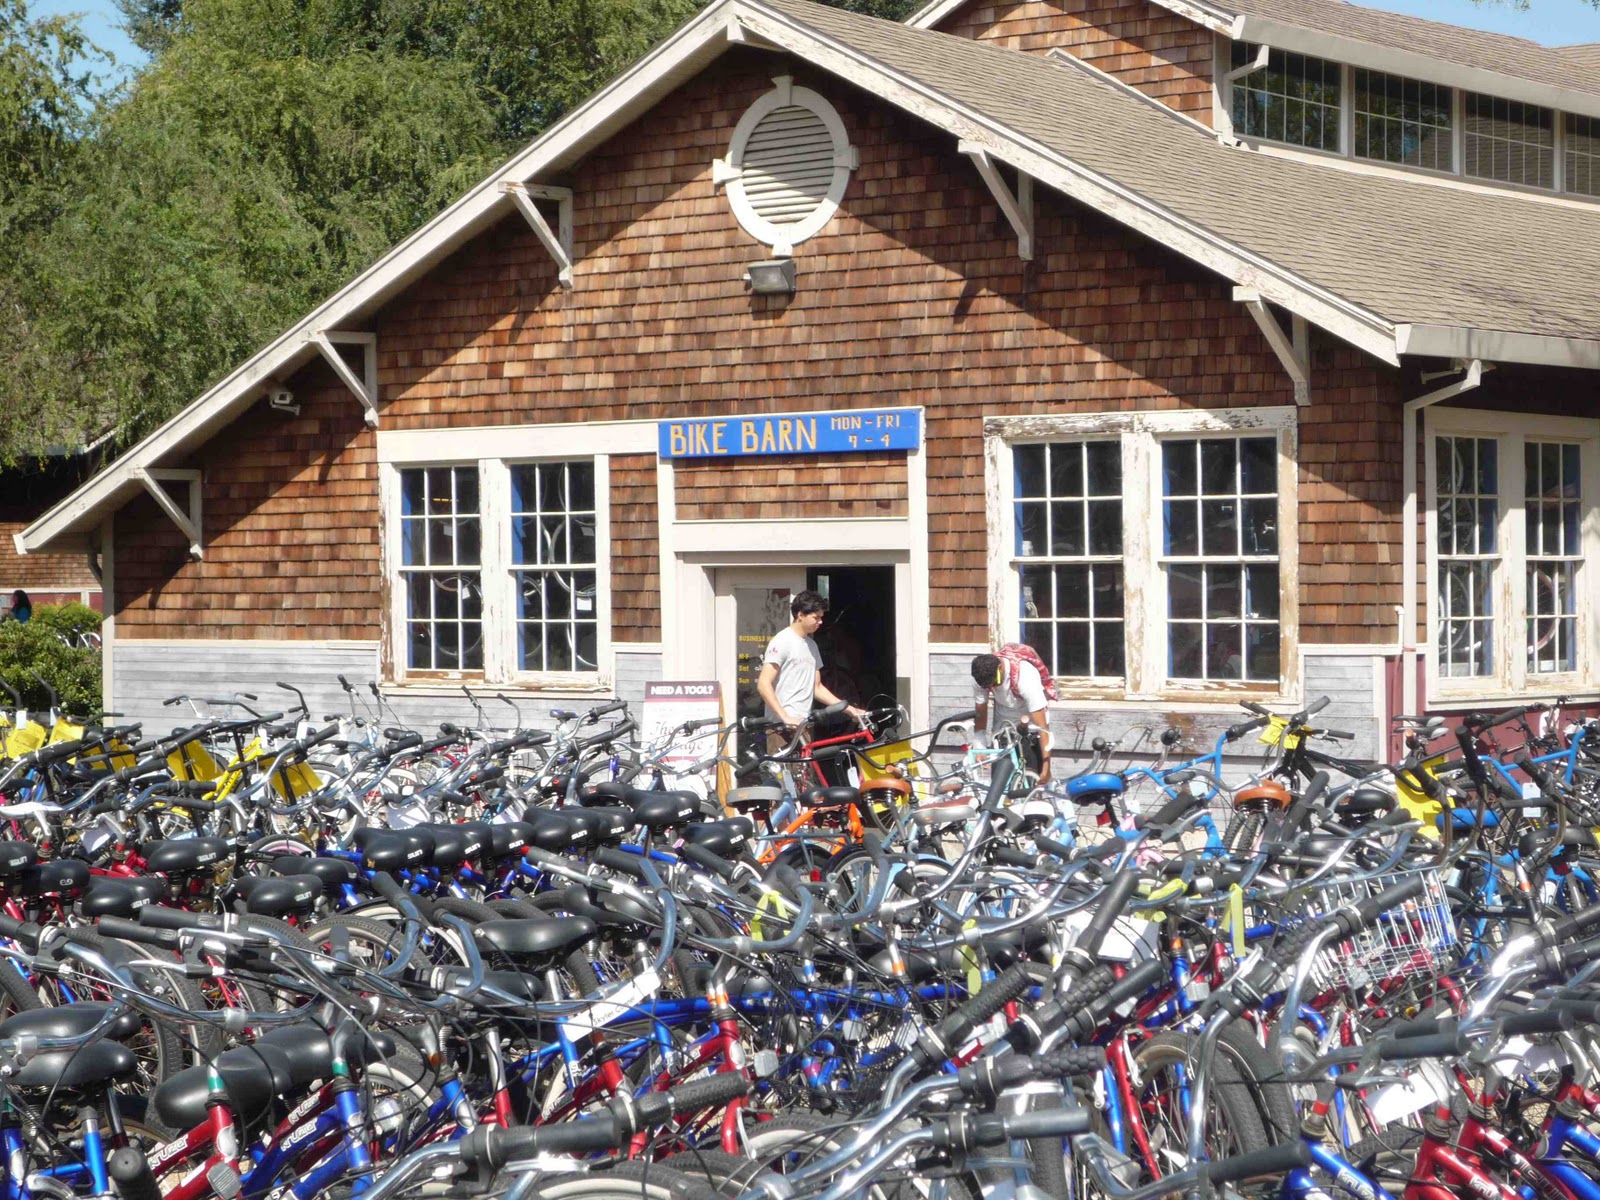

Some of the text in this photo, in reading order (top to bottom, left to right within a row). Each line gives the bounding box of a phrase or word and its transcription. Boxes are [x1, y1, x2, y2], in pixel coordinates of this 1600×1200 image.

[670, 418, 817, 455] BIKE BARN
[651, 685, 714, 695] NEED A TOOL?
